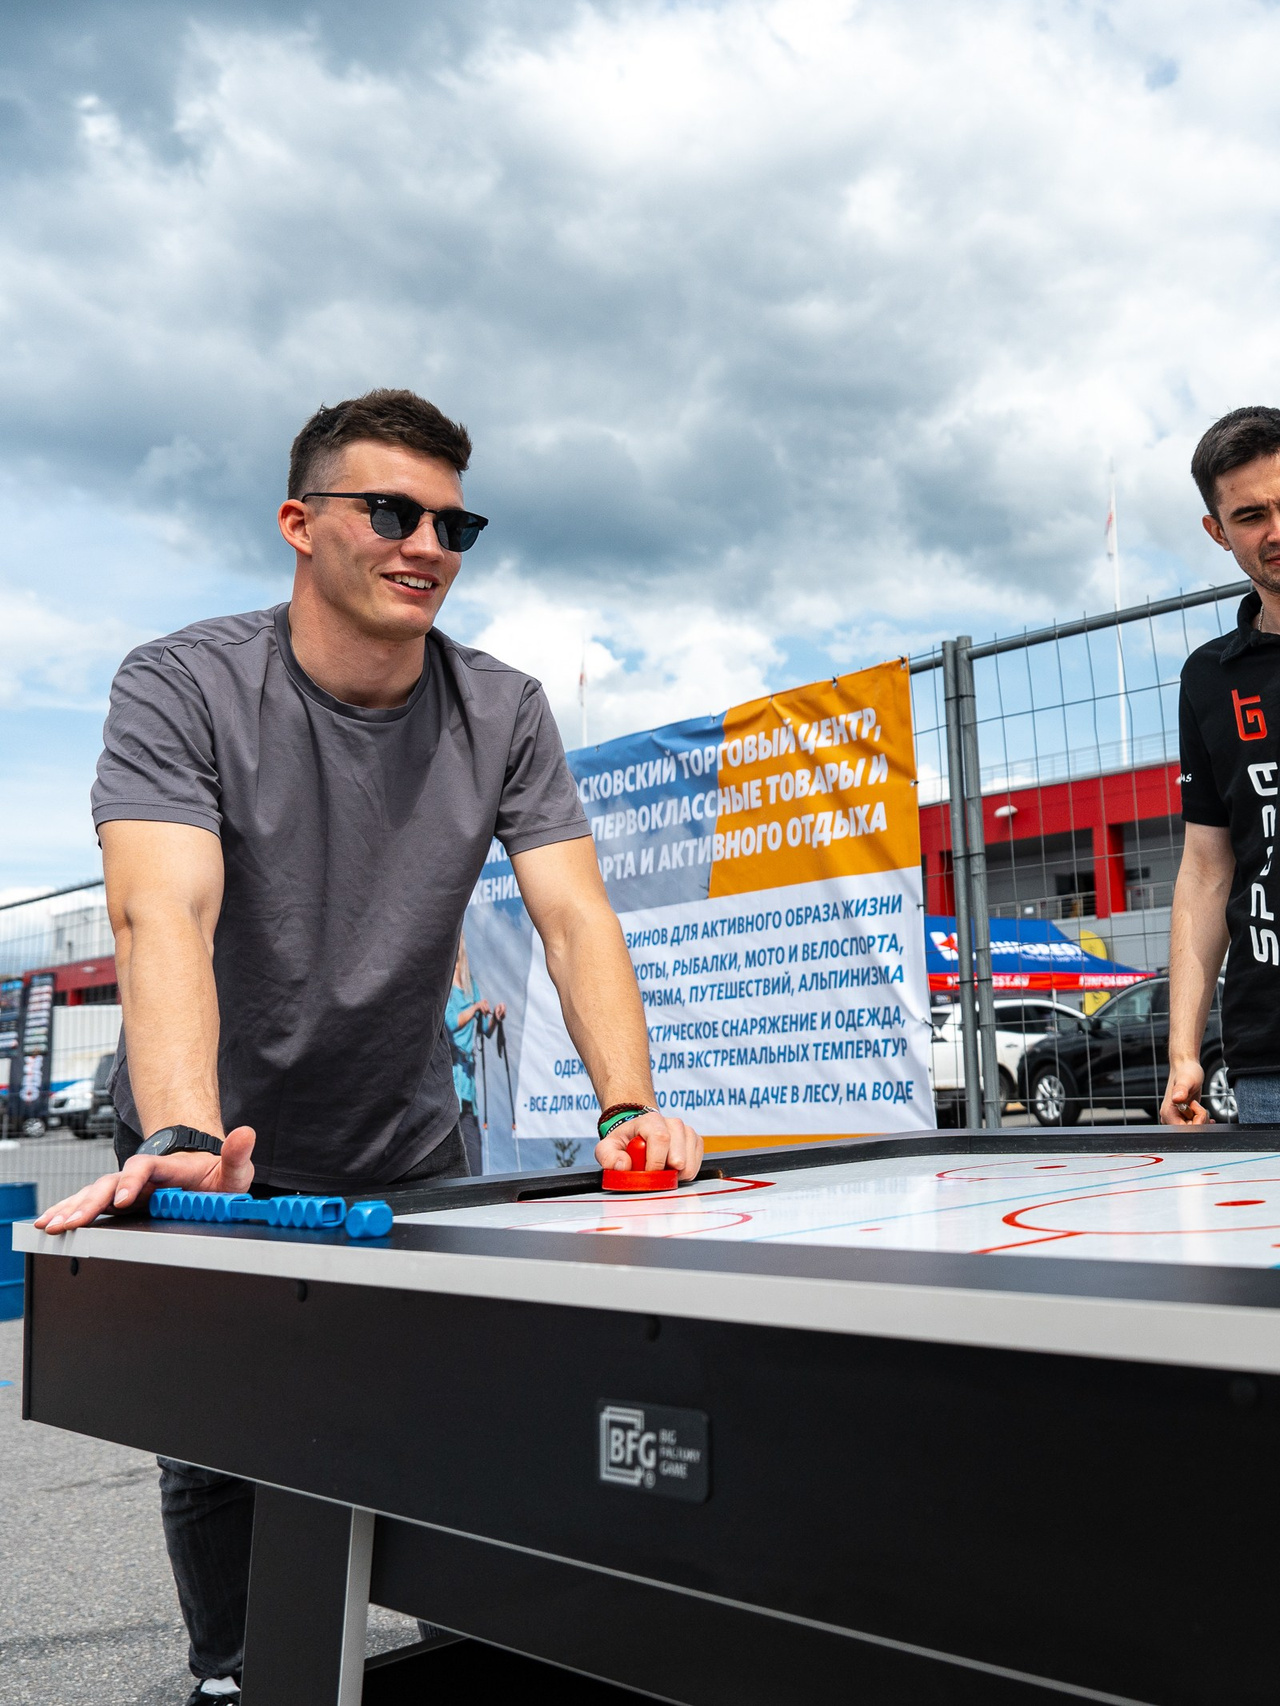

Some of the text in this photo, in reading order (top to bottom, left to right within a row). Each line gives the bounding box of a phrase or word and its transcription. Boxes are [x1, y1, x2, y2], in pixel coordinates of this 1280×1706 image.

[577, 707, 882, 804] СКОВСКИЙ ТОРГОВЫЙ ЦЕНТР,
[590, 753, 889, 842] ПЕРВОКЛАССНЫЕ ТОВАРЫ И
[598, 850, 637, 882] РТА
[640, 849, 654, 874] И
[658, 821, 783, 872] АКТИВНОГО
[786, 802, 887, 848] ОТДЫХА
[626, 894, 903, 949] ЗИНОВ ДЛЯ АКТИВНОГО ОБРАЗА ЖИЗНИ
[633, 933, 904, 981] ХОТЫ, РЫБАЛКИ, МОТО И ВЕЛОСПОРТА,
[642, 965, 904, 1007] РИЗМА, ПУТЕШЕСТВИЙ, АЛЬПИНИЗМА
[648, 1006, 907, 1043] КТИЧЕСКОЕ СНАРЯЖЕНИЕ И ОДЕЖДА,
[554, 1059, 588, 1078] ОДЕЖ
[658, 1052, 685, 1073] ДЛЯ
[687, 1044, 810, 1069] ЭКСТРЕМАЛЬНЫХ
[812, 1037, 909, 1063] ТЕМПЕРАТУР
[530, 1096, 547, 1112] ВСЕ
[549, 1095, 573, 1114] ДЛЯ
[575, 1093, 601, 1111] КОМ
[670, 1087, 725, 1112] ОТДЫХА
[728, 1085, 748, 1106] НА
[750, 1084, 787, 1108] ДАЧЕ
[791, 1084, 800, 1104] В
[802, 1082, 843, 1106] ЛЕСУ,
[846, 1082, 868, 1102] НА
[872, 1080, 914, 1104] ВОДЕ
[610, 1427, 657, 1470] BFG
